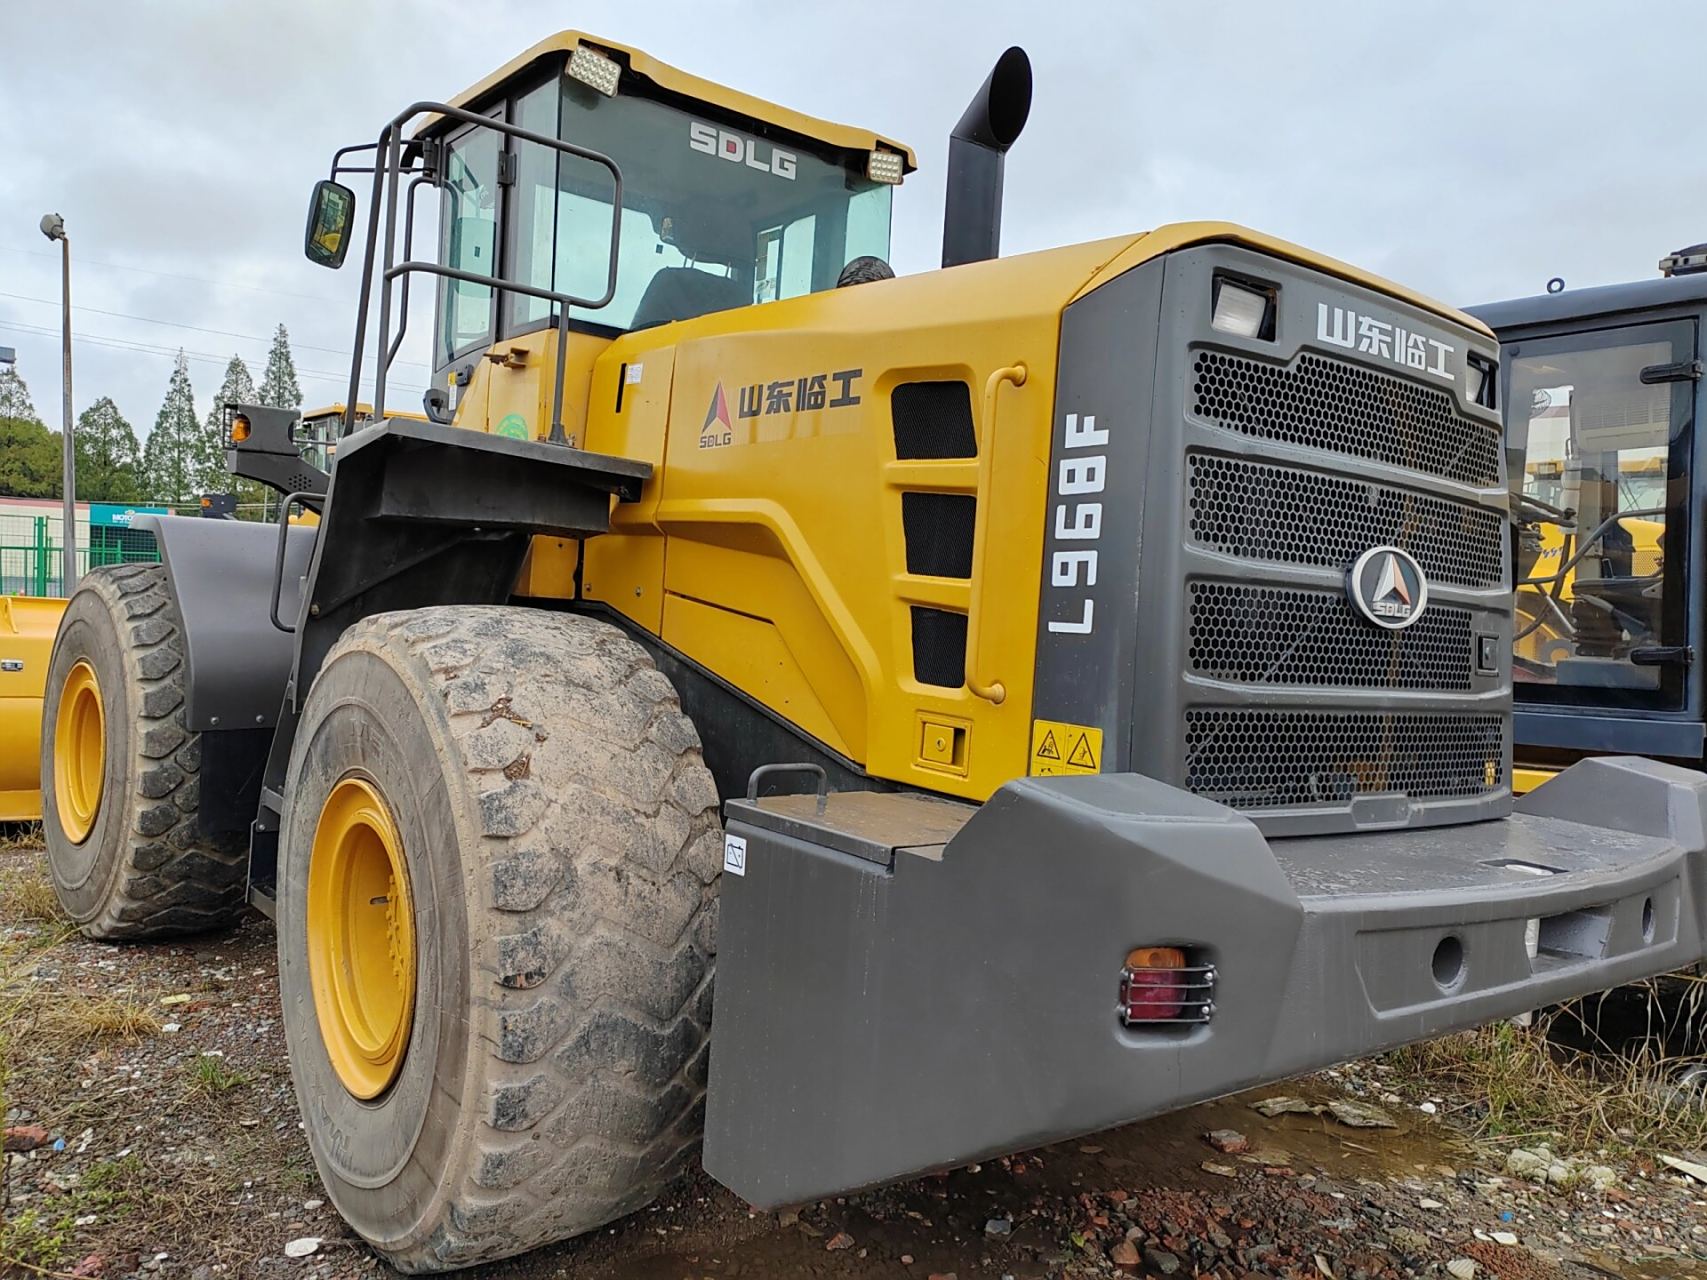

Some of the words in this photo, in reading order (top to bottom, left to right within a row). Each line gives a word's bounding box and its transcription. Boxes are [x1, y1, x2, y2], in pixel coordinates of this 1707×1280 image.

[690, 121, 797, 181] SDLG
[1316, 302, 1455, 380] 山东临工
[738, 368, 863, 419] 山东临工
[699, 432, 732, 449] SDLG
[1047, 413, 1110, 634] L968F
[1372, 601, 1411, 618] SDLG
